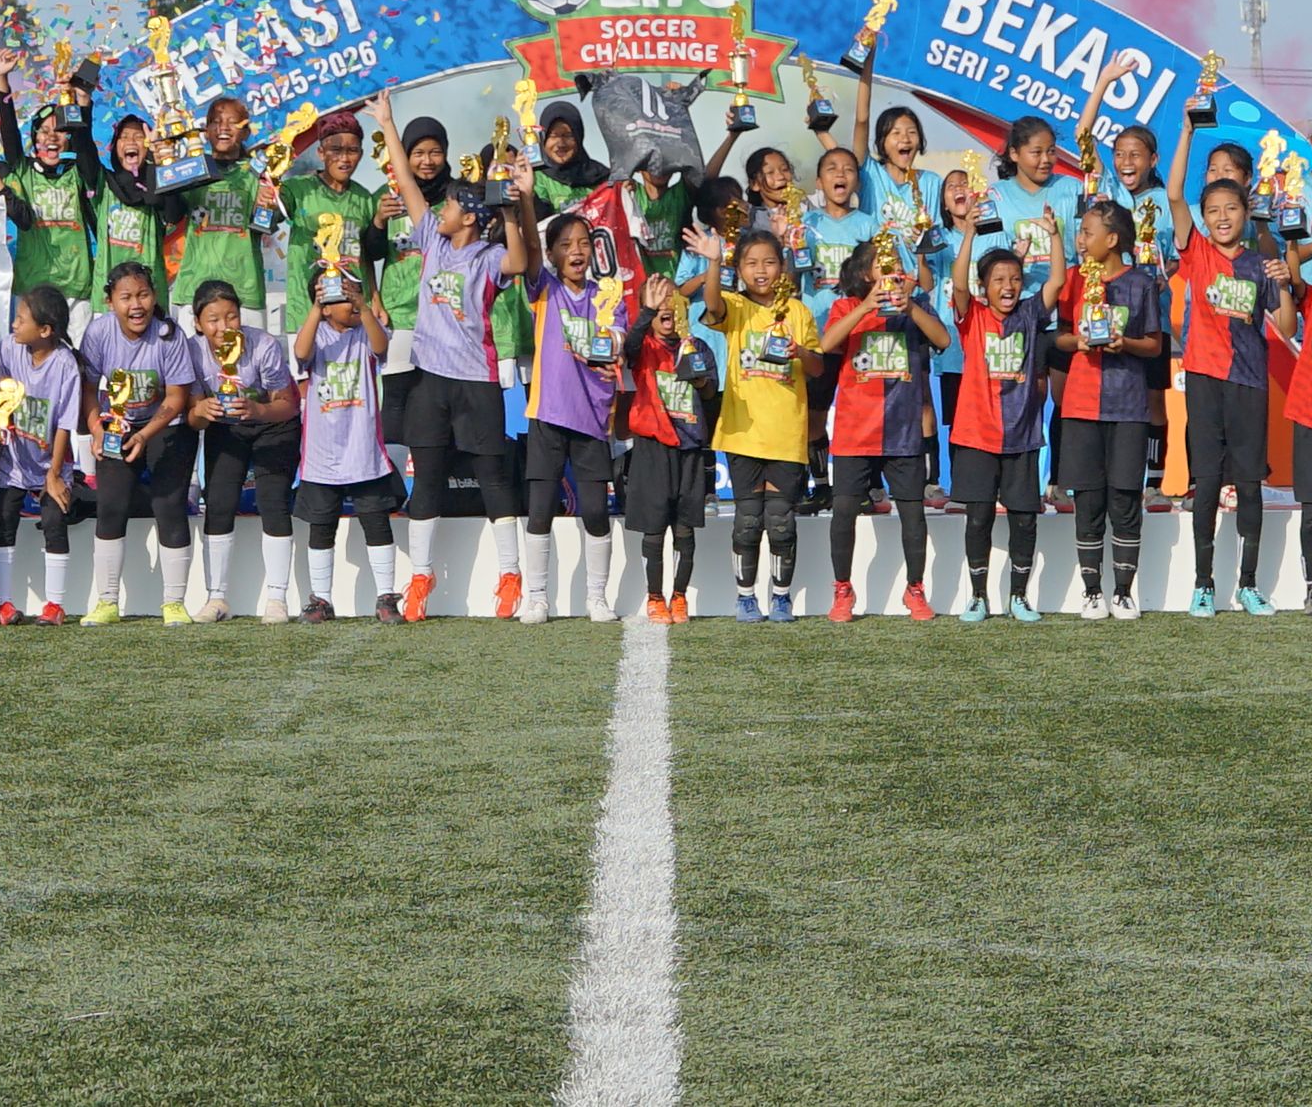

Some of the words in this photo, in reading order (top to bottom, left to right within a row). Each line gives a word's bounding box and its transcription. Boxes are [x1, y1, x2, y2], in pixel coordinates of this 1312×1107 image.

[600, 19, 697, 40] SOCCER
[580, 41, 719, 64] CHALLENGE
[926, 39, 989, 82] SERI
[989, 64, 1010, 91] 2
[246, 40, 377, 116] 2025-2026
[205, 192, 242, 210] Milk
[209, 208, 244, 226] Life
[866, 334, 904, 353] Milk
[872, 352, 907, 372] Life
[988, 353, 1023, 372] Life
